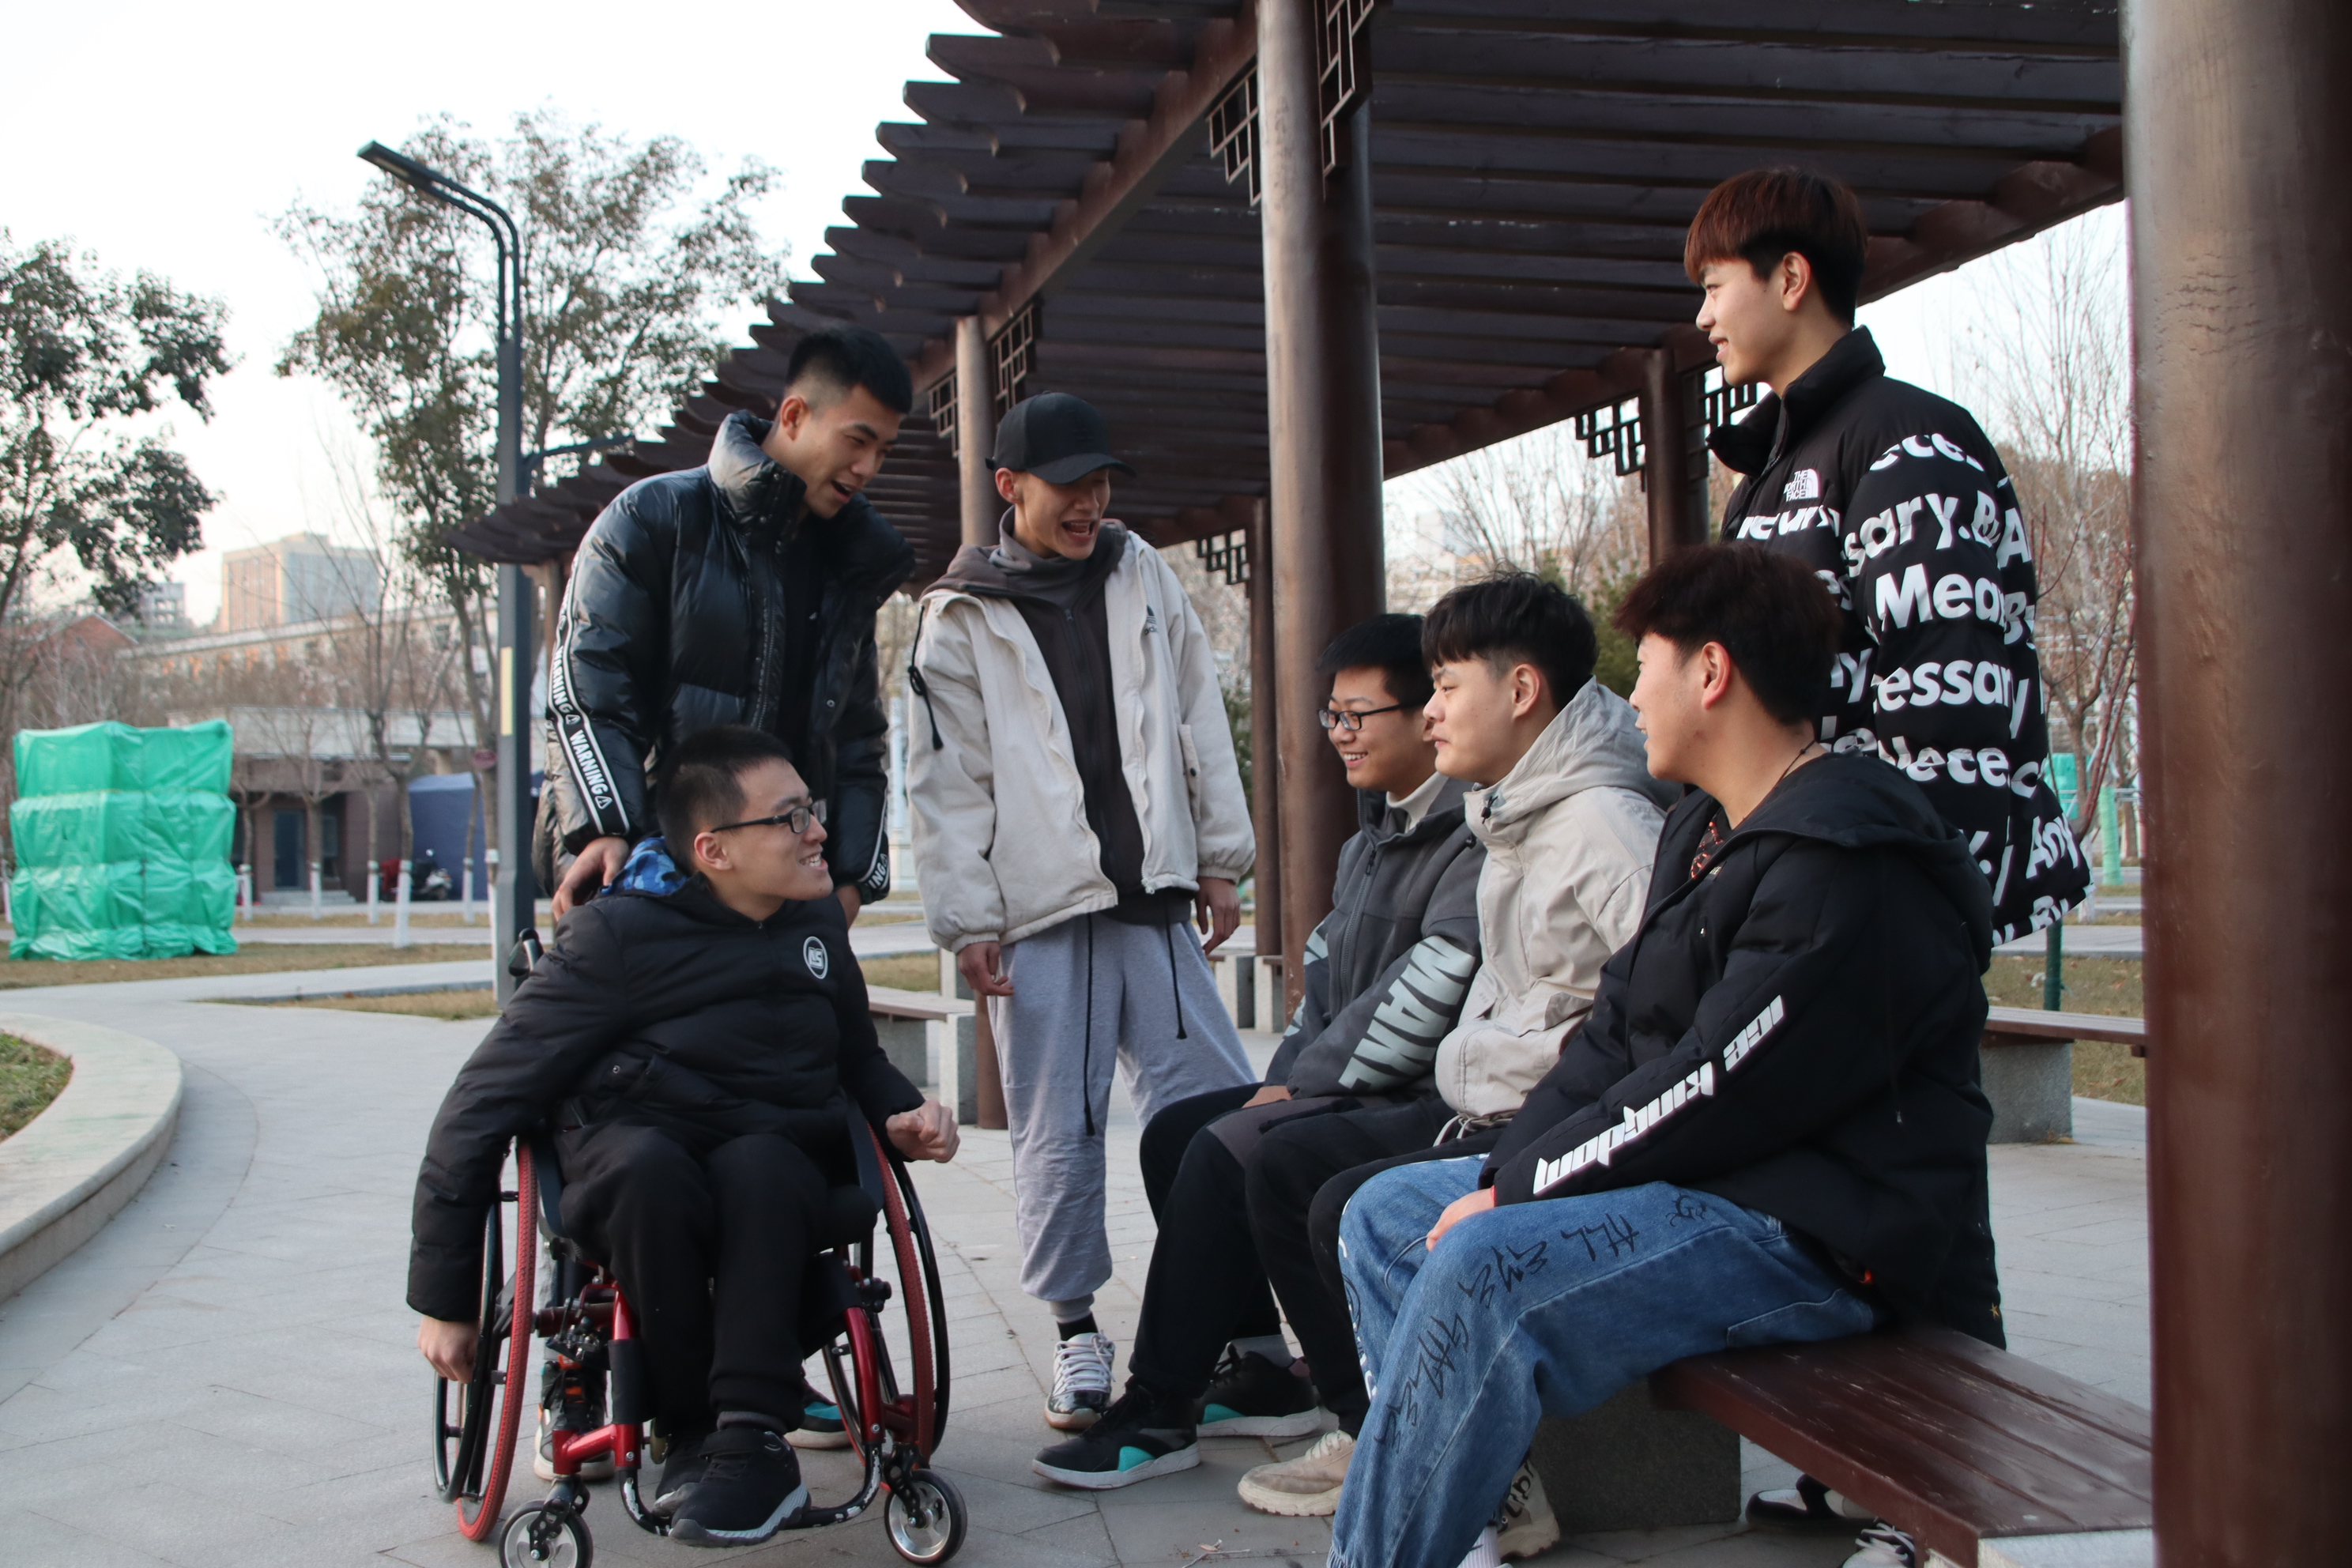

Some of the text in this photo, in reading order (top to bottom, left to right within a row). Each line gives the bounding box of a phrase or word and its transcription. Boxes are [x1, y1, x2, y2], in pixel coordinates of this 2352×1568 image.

[1786, 490, 1806, 502] FACE
[1794, 470, 1808, 481] THE
[552, 645, 573, 713] WARNING
[569, 729, 609, 795] WARNING
[1561, 1212, 1639, 1264] ALL
